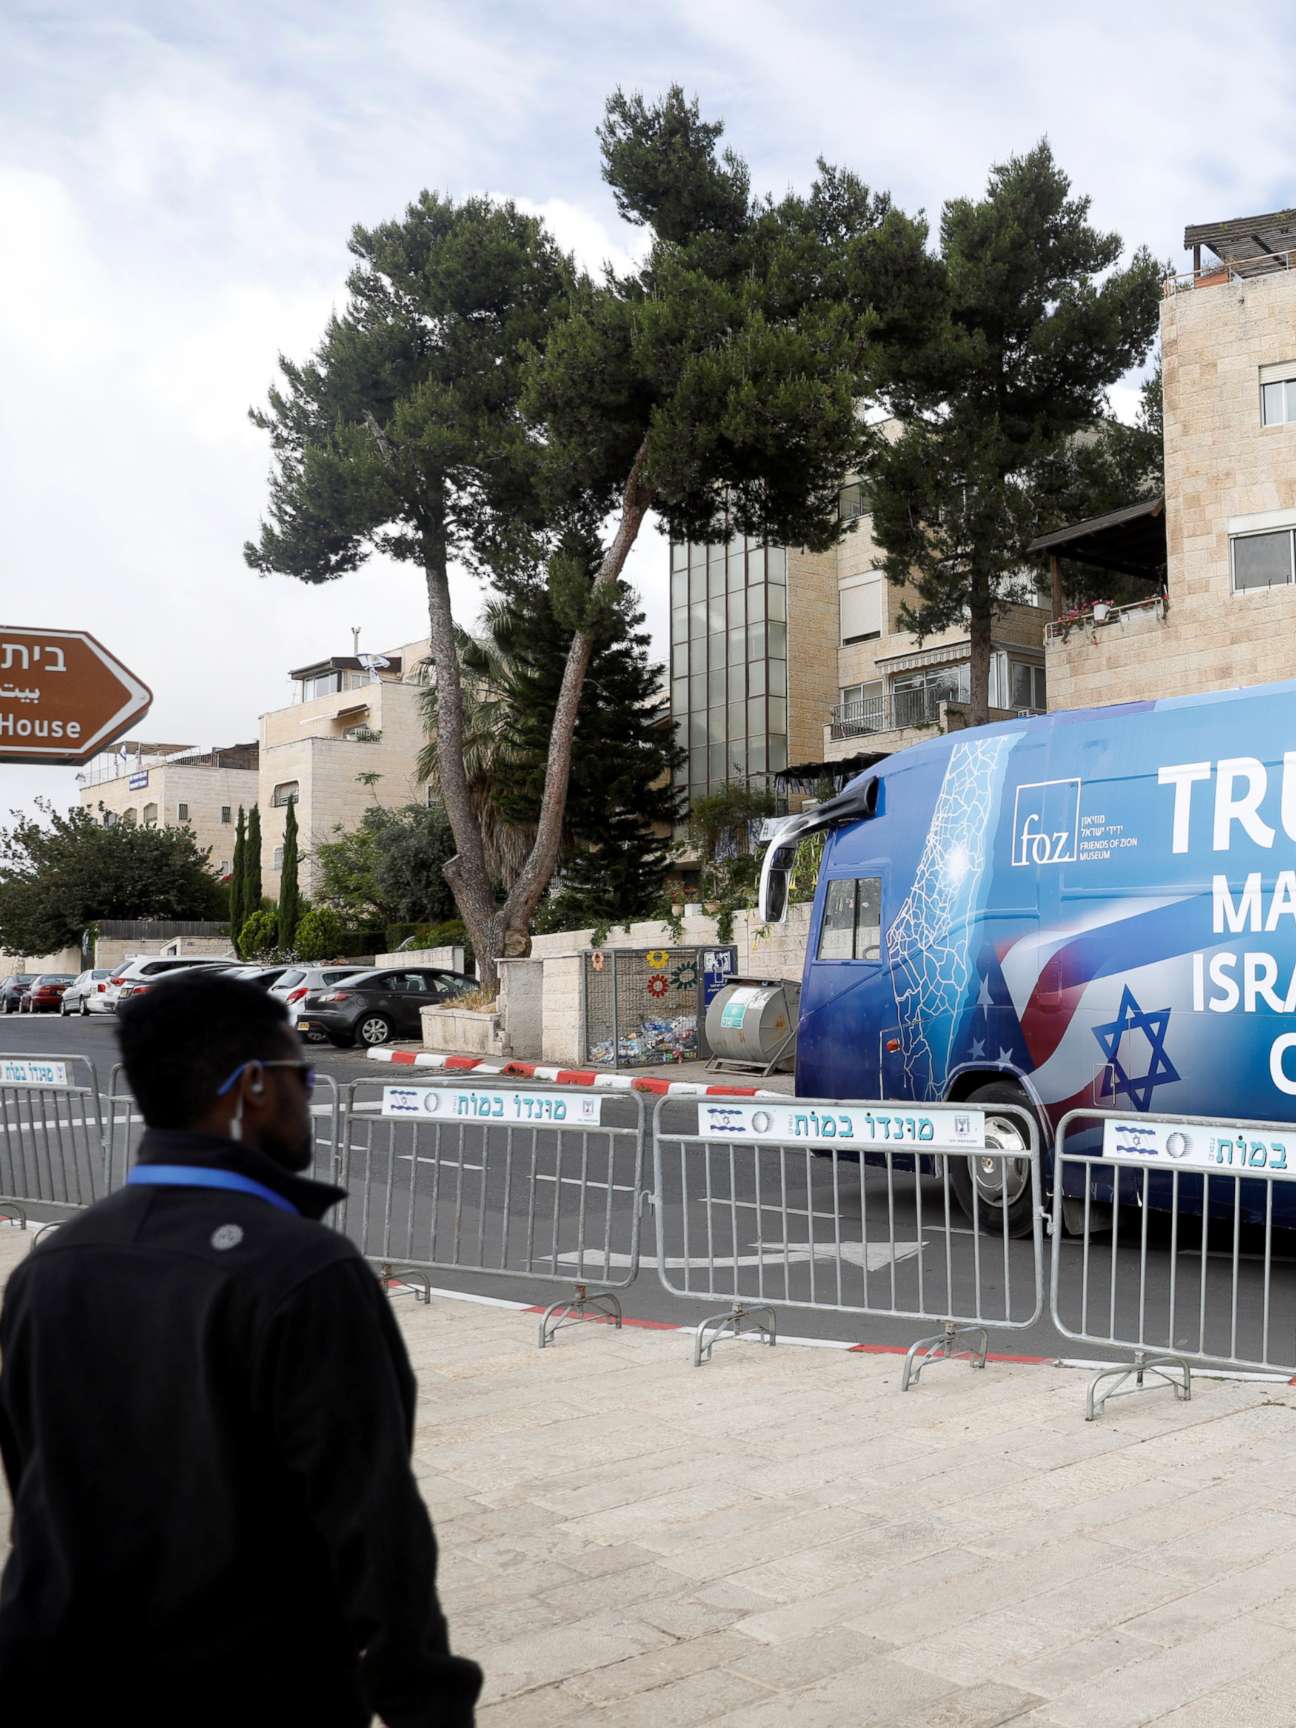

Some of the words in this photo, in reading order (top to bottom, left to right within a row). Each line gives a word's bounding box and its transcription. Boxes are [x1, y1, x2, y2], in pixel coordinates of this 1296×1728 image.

[0, 643, 67, 672] בית
[0, 683, 40, 704] بيت
[0, 712, 81, 738] House
[1020, 814, 1070, 865] foz
[1080, 840, 1109, 850] FRIENDS
[1119, 837, 1138, 848] ZION
[1080, 850, 1111, 861] MUSEUM
